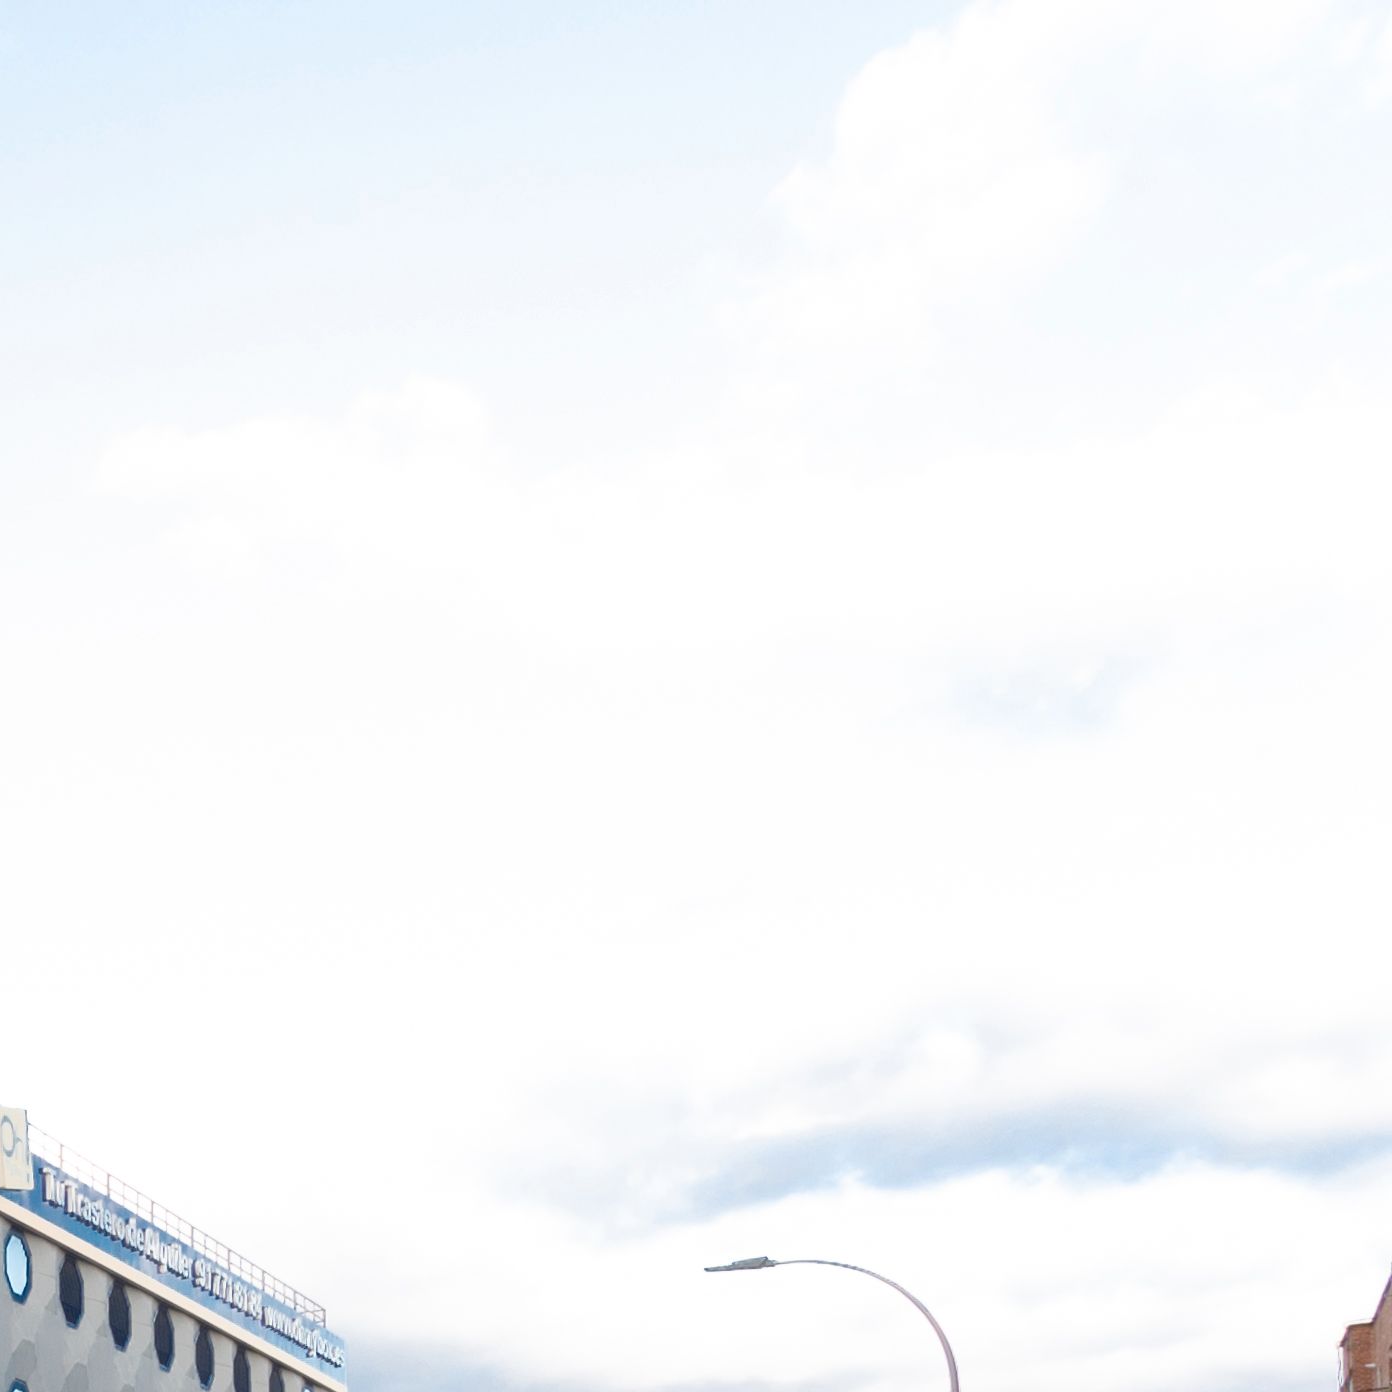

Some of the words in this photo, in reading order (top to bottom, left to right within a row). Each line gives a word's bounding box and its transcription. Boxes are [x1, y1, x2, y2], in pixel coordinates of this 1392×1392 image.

[42, 1166, 66, 1206] Tu
[65, 1180, 125, 1241] Trastero
[125, 1217, 144, 1251] de
[143, 1228, 193, 1279] Alquiler
